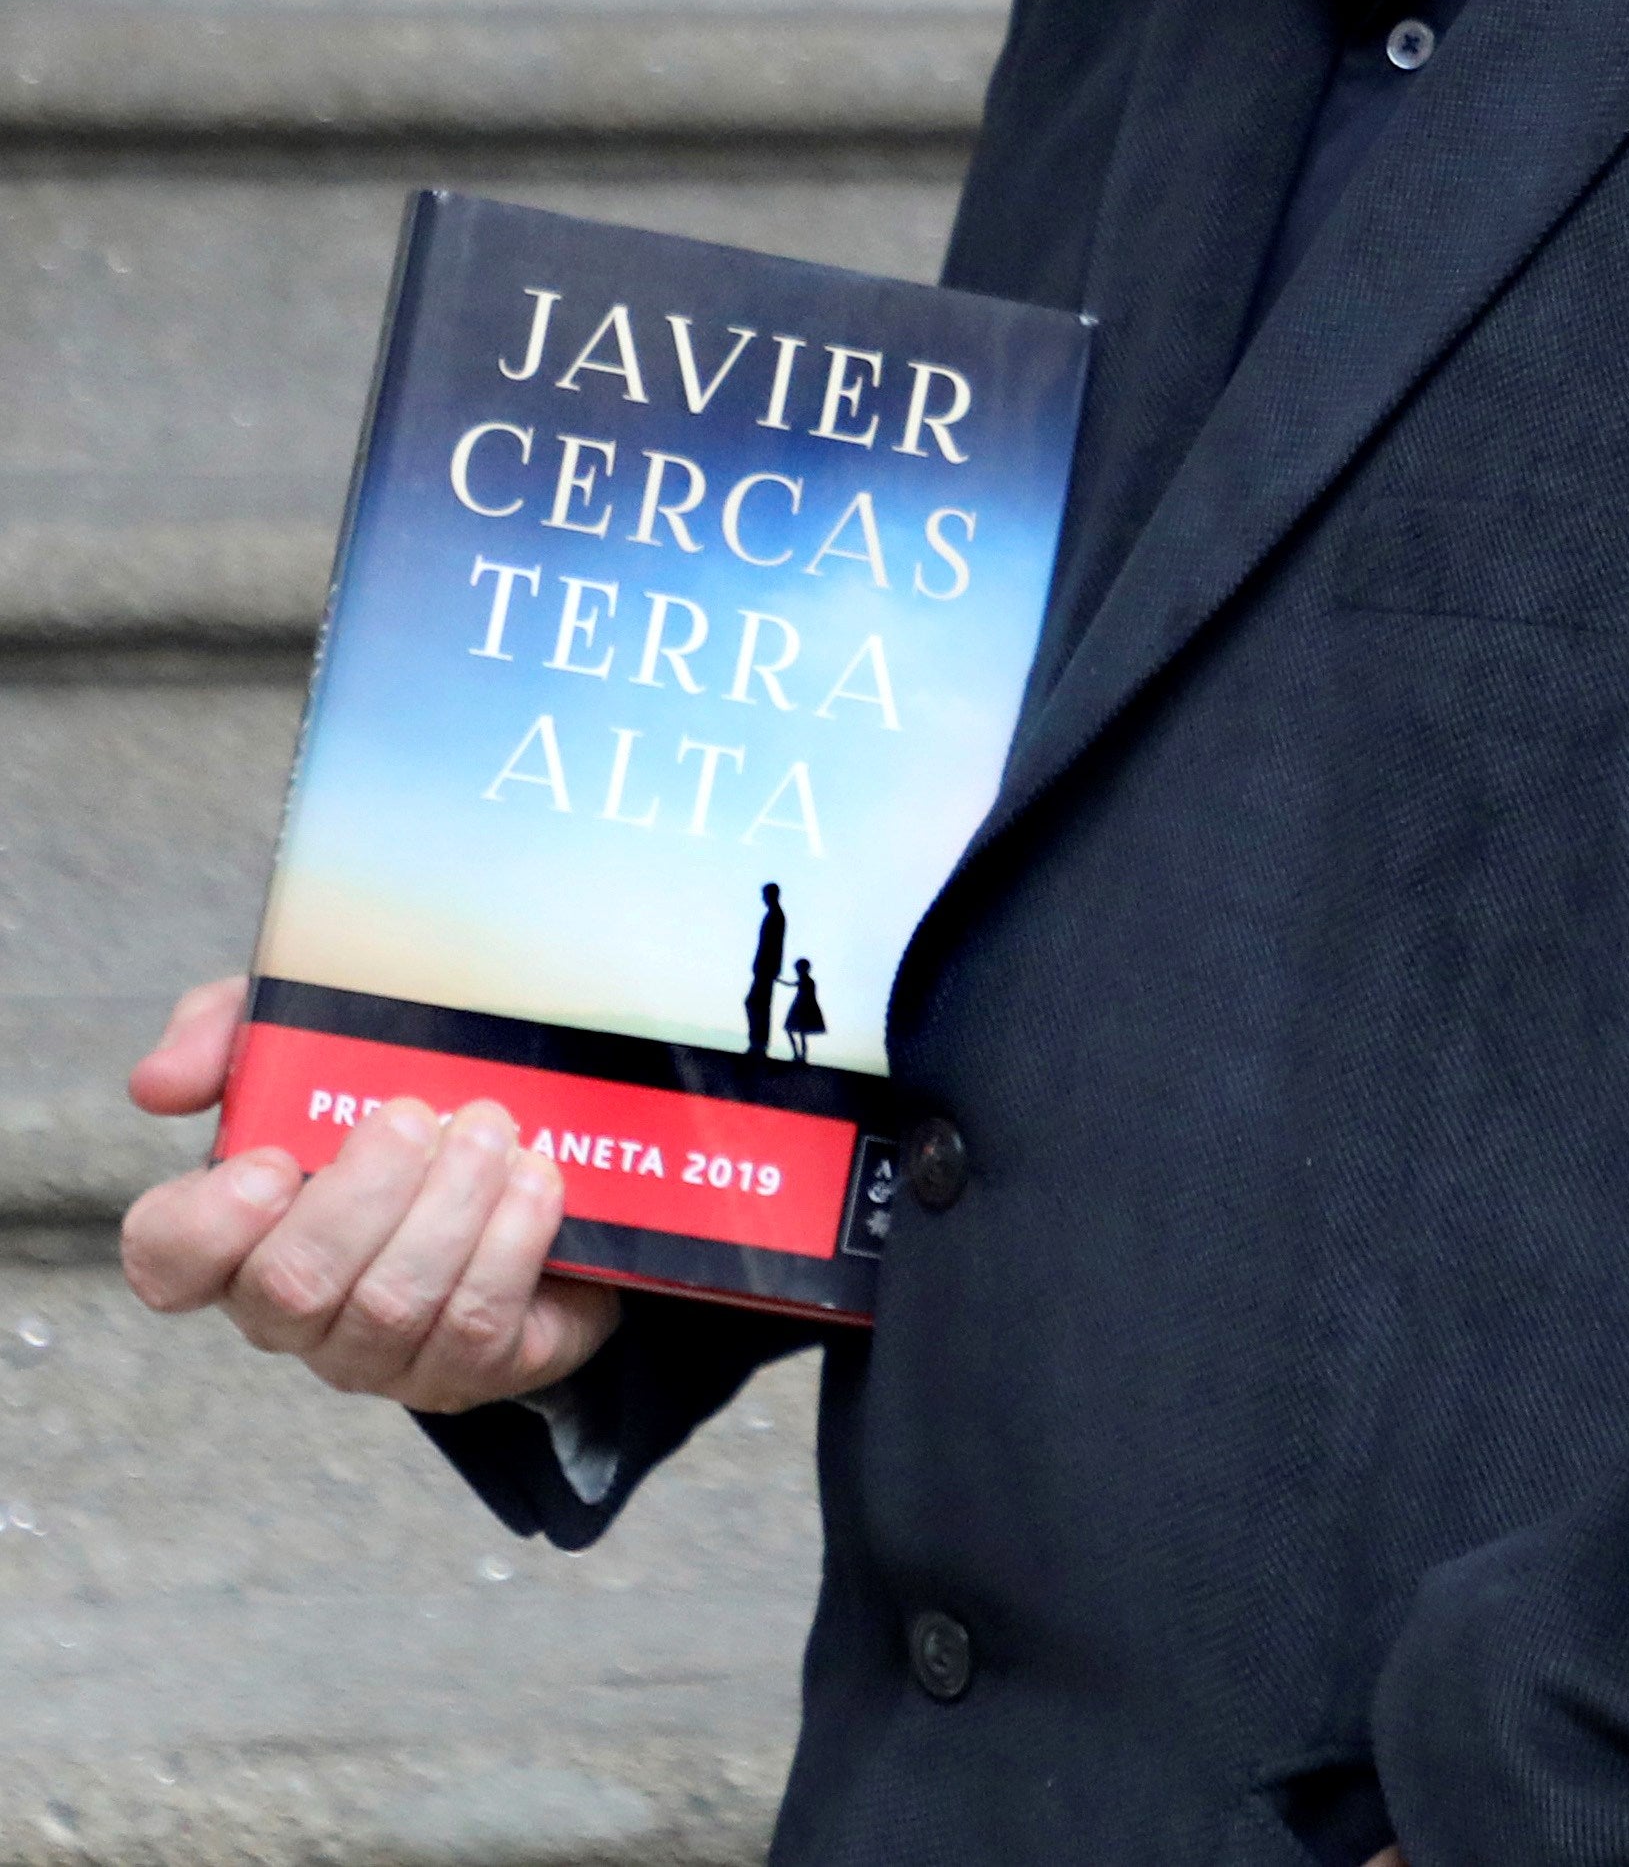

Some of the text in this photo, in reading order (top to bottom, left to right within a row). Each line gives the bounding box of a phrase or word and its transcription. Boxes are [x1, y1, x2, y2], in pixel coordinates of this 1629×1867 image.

[498, 287, 973, 465] JAVIER
[450, 421, 978, 602] CERCAS
[467, 554, 904, 732] TERRA
[480, 713, 827, 860] ALTA
[516, 1124, 665, 1179] ANETA
[682, 1151, 781, 1197] 2019
